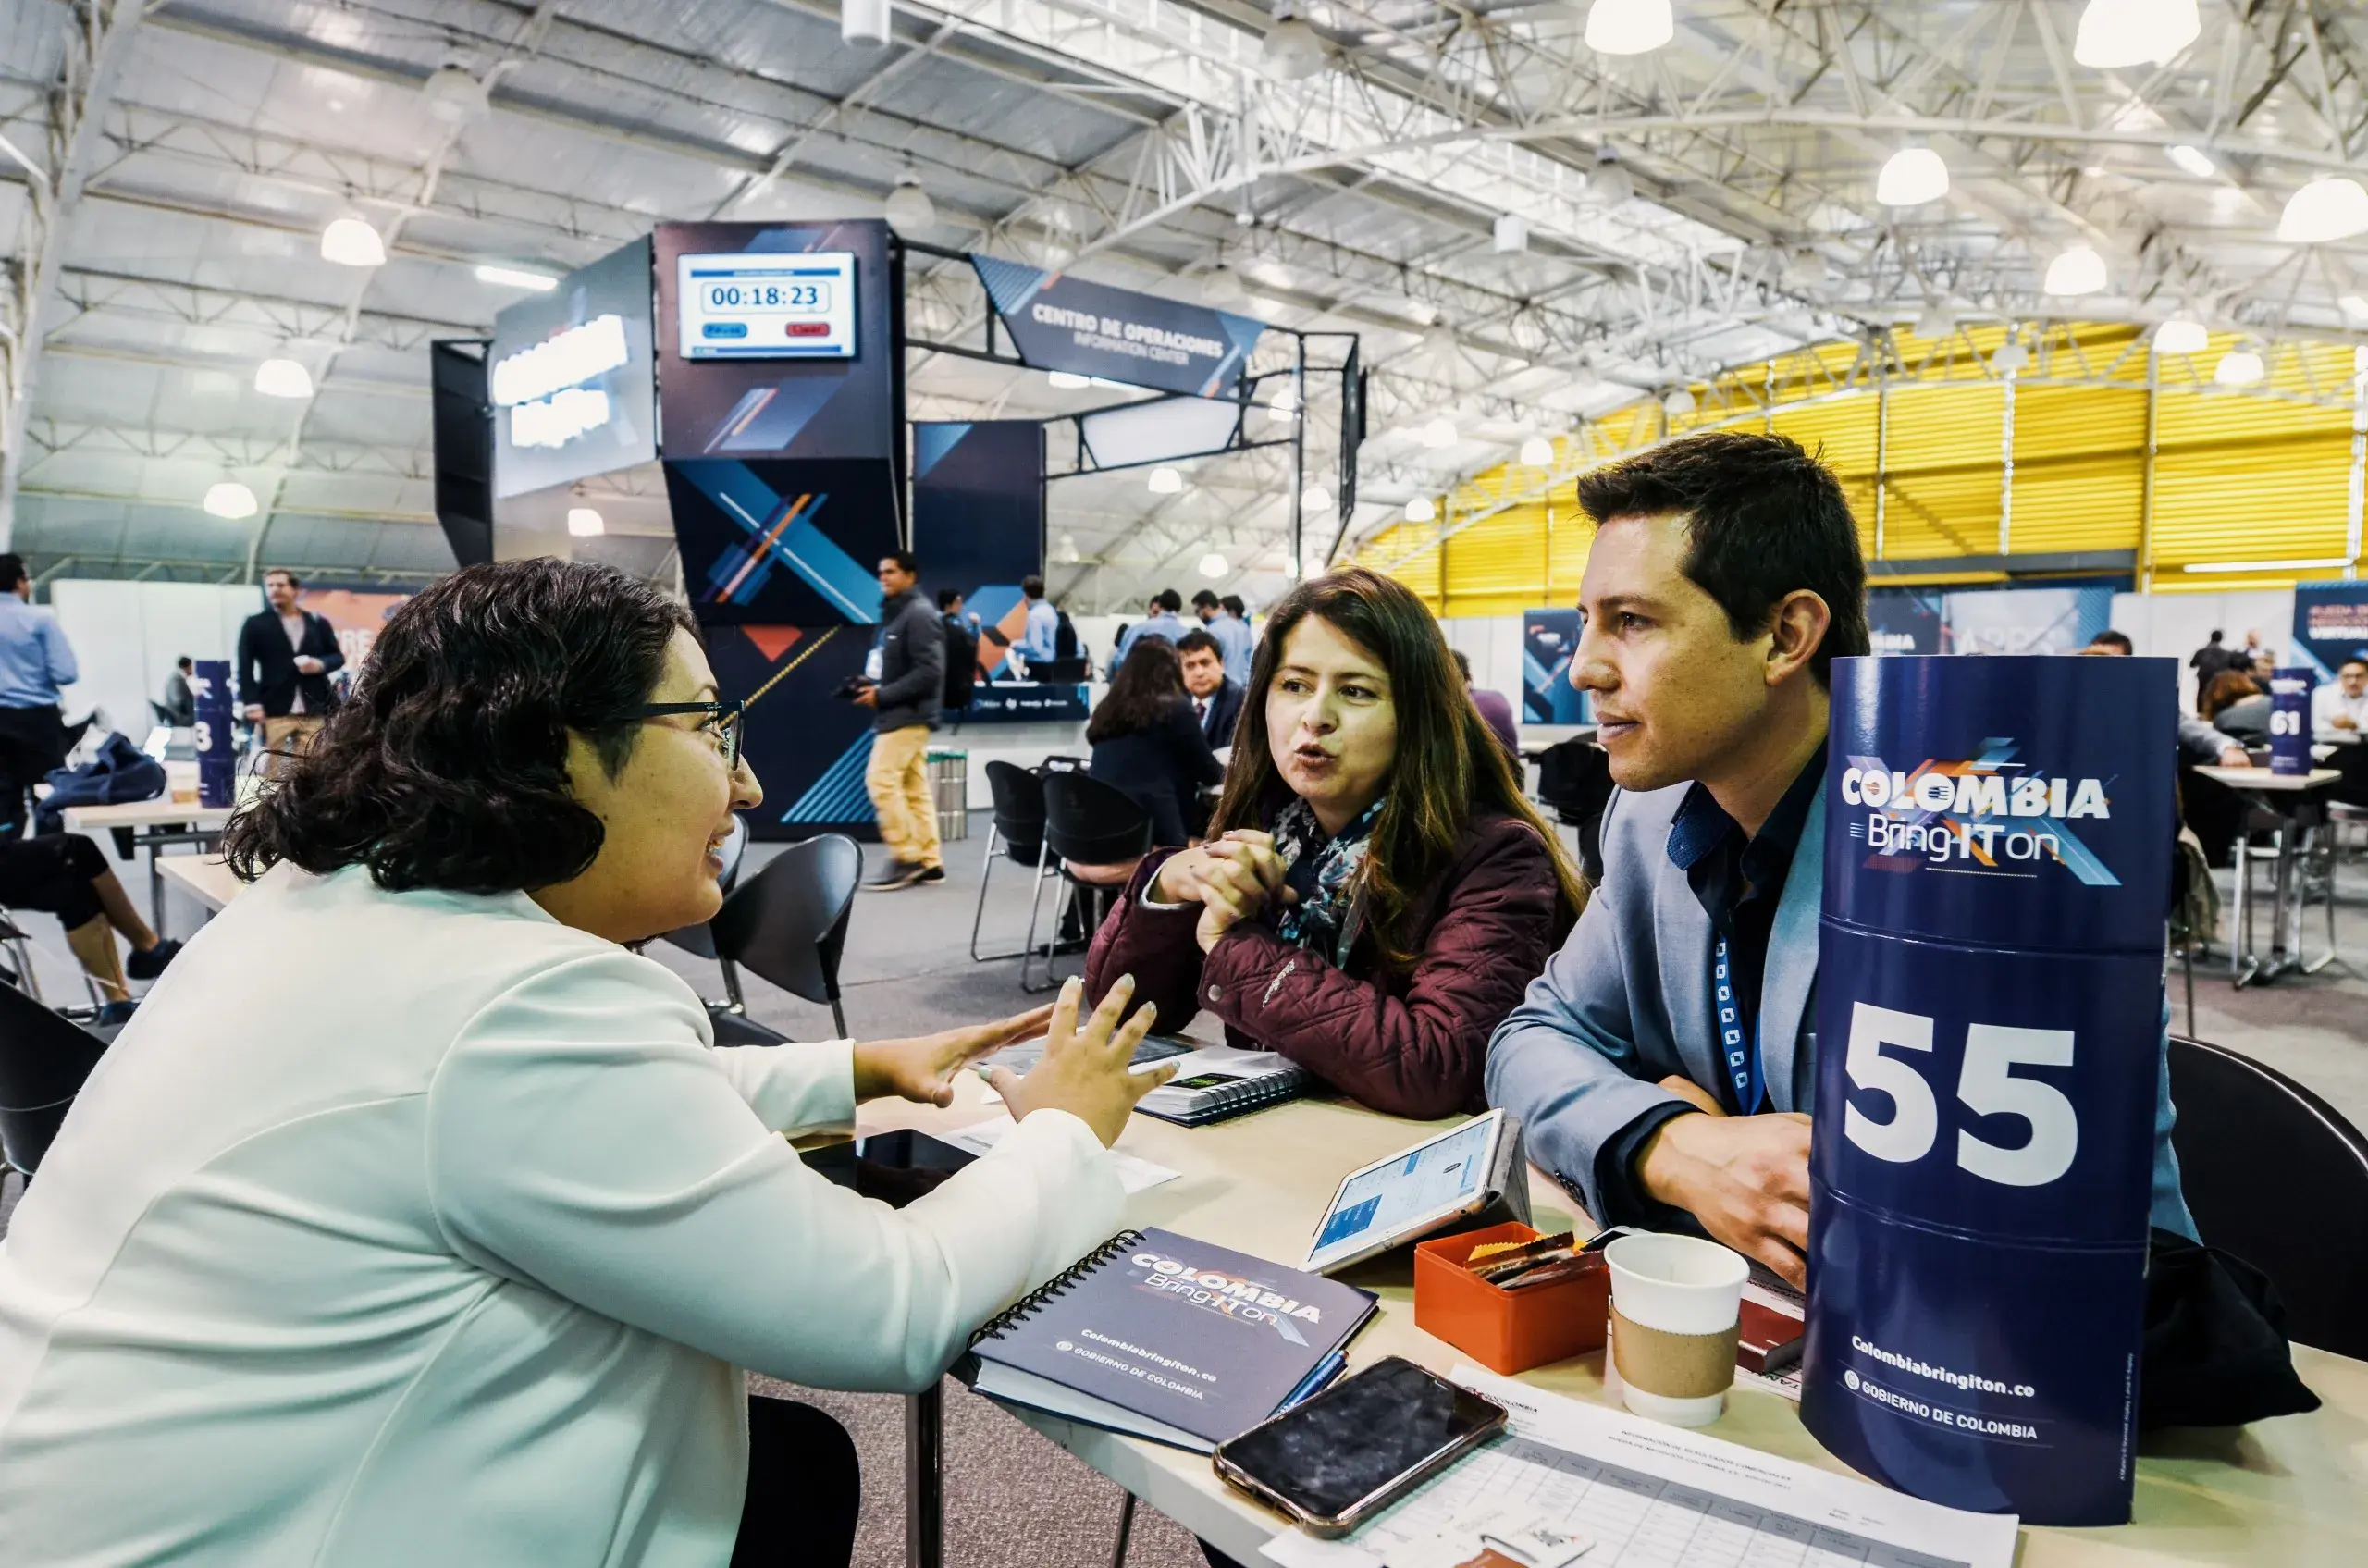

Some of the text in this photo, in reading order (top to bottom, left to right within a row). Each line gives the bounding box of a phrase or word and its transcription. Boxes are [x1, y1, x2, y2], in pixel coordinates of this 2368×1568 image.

[711, 287, 818, 305] 00:18:23
[1032, 303, 1224, 358] CENTRO DE OPERACIONES
[1842, 767, 2110, 819] COLOMBIA
[1844, 1001, 2078, 1187] 55
[1131, 1253, 1321, 1324] COLOMBIA
[1074, 1347, 1203, 1400] GOBIERNO DE COLOMBIA
[1081, 1328, 1217, 1382] Colombiabringiton.co
[1852, 1335, 2035, 1398] Colombiabringiton.co
[1862, 1381, 2038, 1439] GOBIERNO DE COLOMBIA
